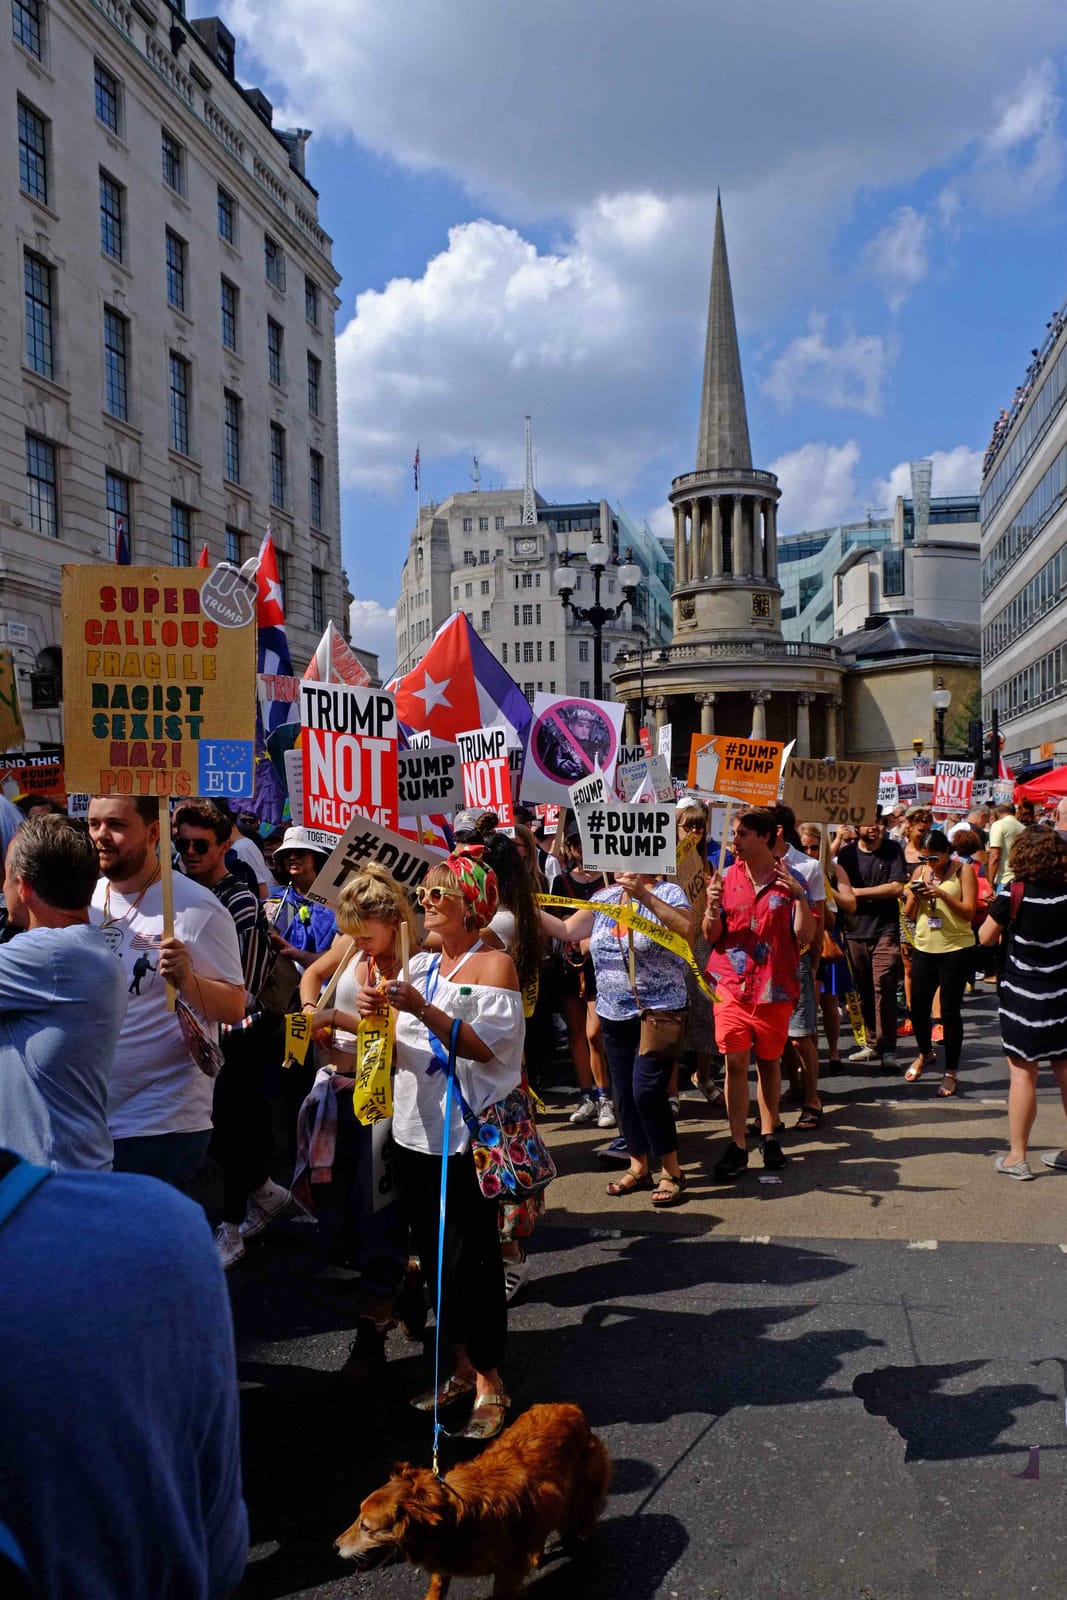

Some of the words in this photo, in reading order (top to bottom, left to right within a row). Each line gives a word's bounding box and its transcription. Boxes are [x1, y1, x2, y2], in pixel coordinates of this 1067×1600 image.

[205, 595, 243, 623] TRUMP
[84, 619, 218, 648] CALLOUS
[87, 651, 217, 680] FRAGILE
[92, 683, 204, 712] RACIST
[303, 687, 394, 737] TRUMP
[92, 713, 204, 741] SEXIST
[110, 742, 182, 768] NAZI
[458, 731, 505, 764] TRUMP
[725, 742, 778, 759] #DUMP
[30, 756, 60, 766] THIS
[309, 729, 391, 806] NOT
[725, 757, 774, 774] TRUMP
[790, 761, 863, 784] NOBODY
[938, 762, 973, 777] TRUMP
[100, 769, 191, 796] POTUS
[206, 771, 246, 792] EU
[463, 759, 505, 808] NOT
[573, 779, 603, 804] #DUMP
[936, 775, 968, 799] NOT
[803, 786, 850, 804] LIKES
[587, 811, 670, 834] #DUMP
[825, 806, 865, 823] YOU
[307, 830, 338, 846] TOGETHER
[590, 834, 667, 857] TRUMP
